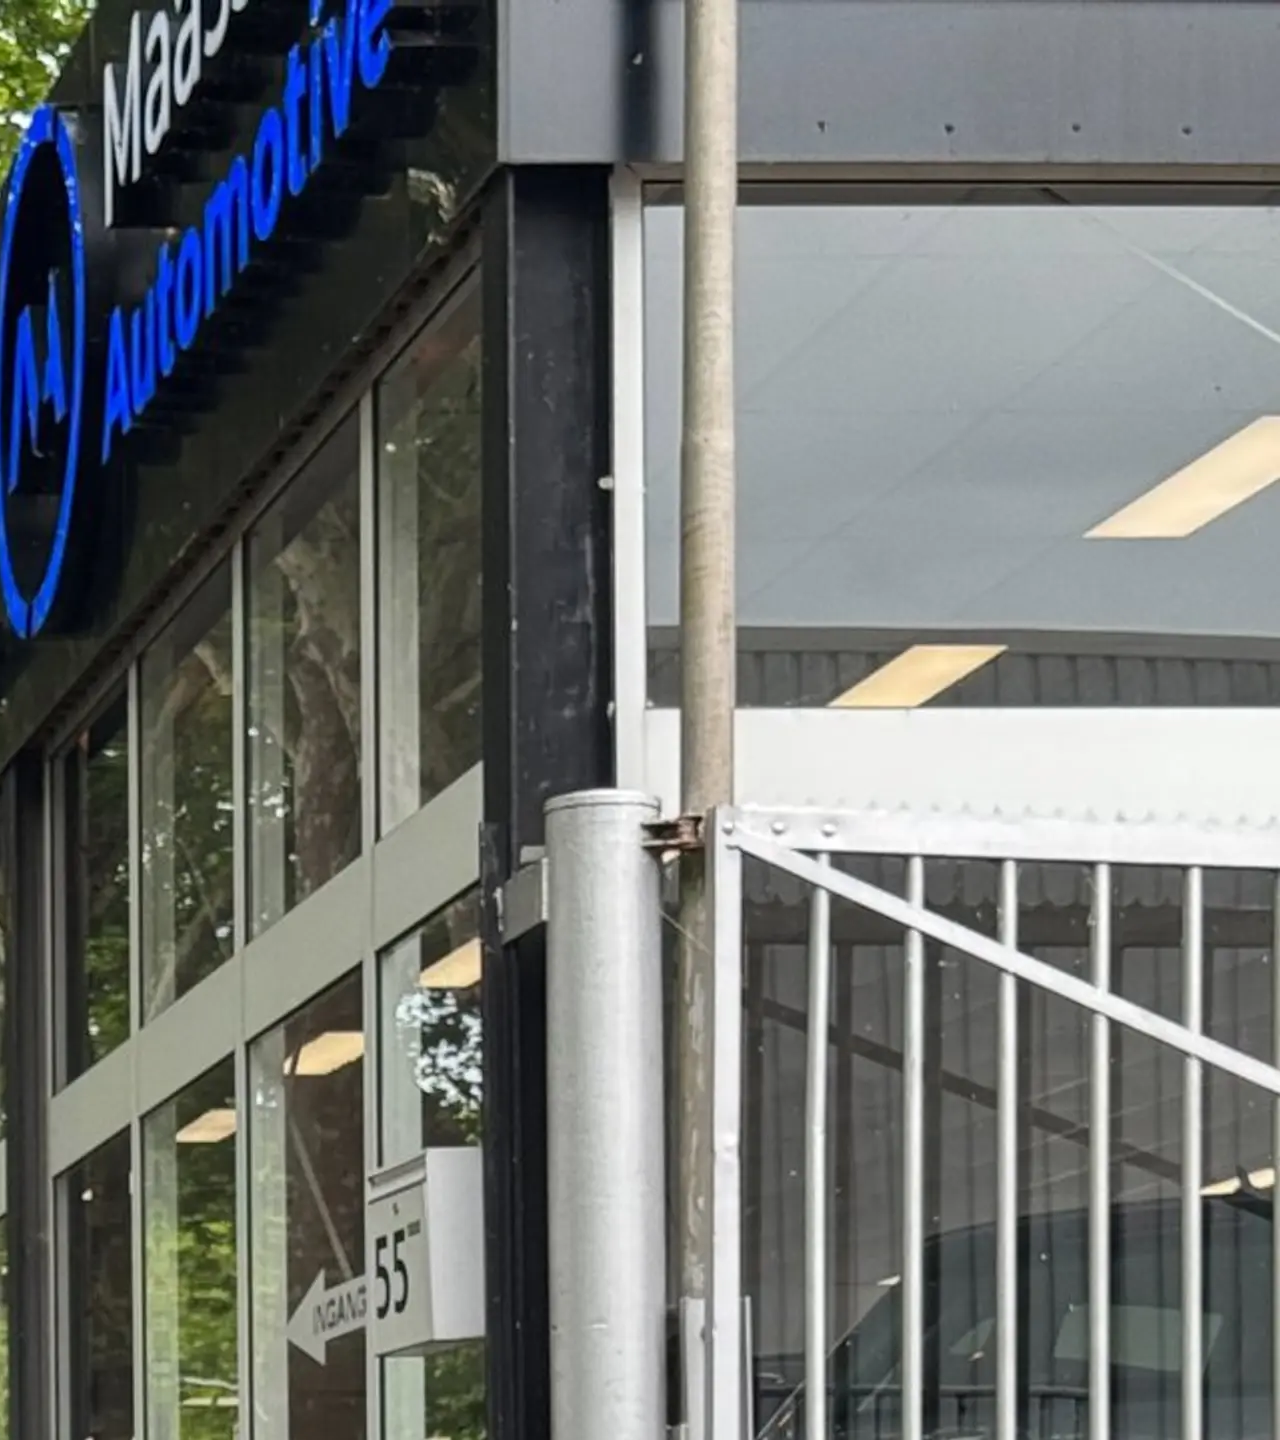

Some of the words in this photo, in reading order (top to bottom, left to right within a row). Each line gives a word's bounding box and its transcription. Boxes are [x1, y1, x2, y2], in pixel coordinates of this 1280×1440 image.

[103, 0, 243, 228] Maa
[102, 0, 393, 466] Automotive
[312, 1284, 367, 1336] INGANG
[375, 1228, 408, 1320] 55
